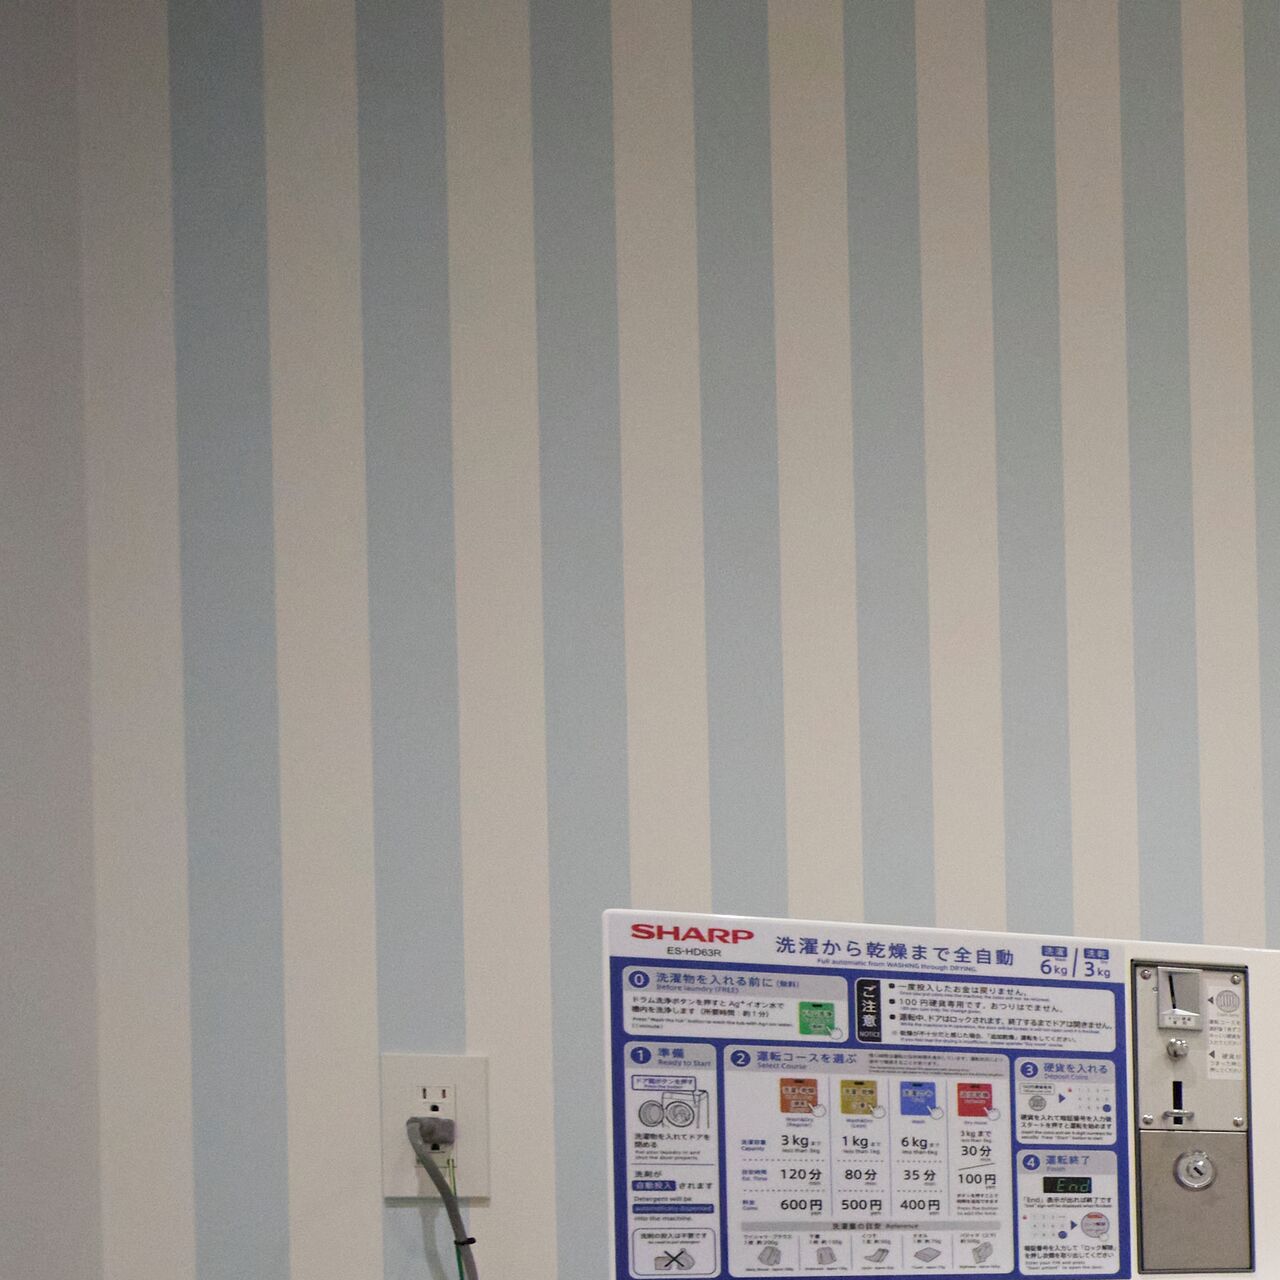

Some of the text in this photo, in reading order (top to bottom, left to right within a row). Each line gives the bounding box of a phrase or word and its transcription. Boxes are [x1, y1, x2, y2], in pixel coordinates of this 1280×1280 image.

[631, 923, 754, 944] SHARP
[667, 946, 722, 957] ES-HD63R
[776, 936, 1014, 966] 洗濯から乾燥まで全自動
[656, 972, 772, 987] 洗濯物を入れる前に
[862, 985, 878, 1027] ご注意
[736, 1052, 746, 1064] 2
[757, 1051, 858, 1065] 運転コースを選ぶ
[1024, 1065, 1034, 1076] 3
[1043, 1062, 1109, 1075] 硬貨を入れる
[1026, 1157, 1036, 1168] 4
[1045, 1155, 1091, 1166] 運転終了
[1056, 1178, 1091, 1193] End
